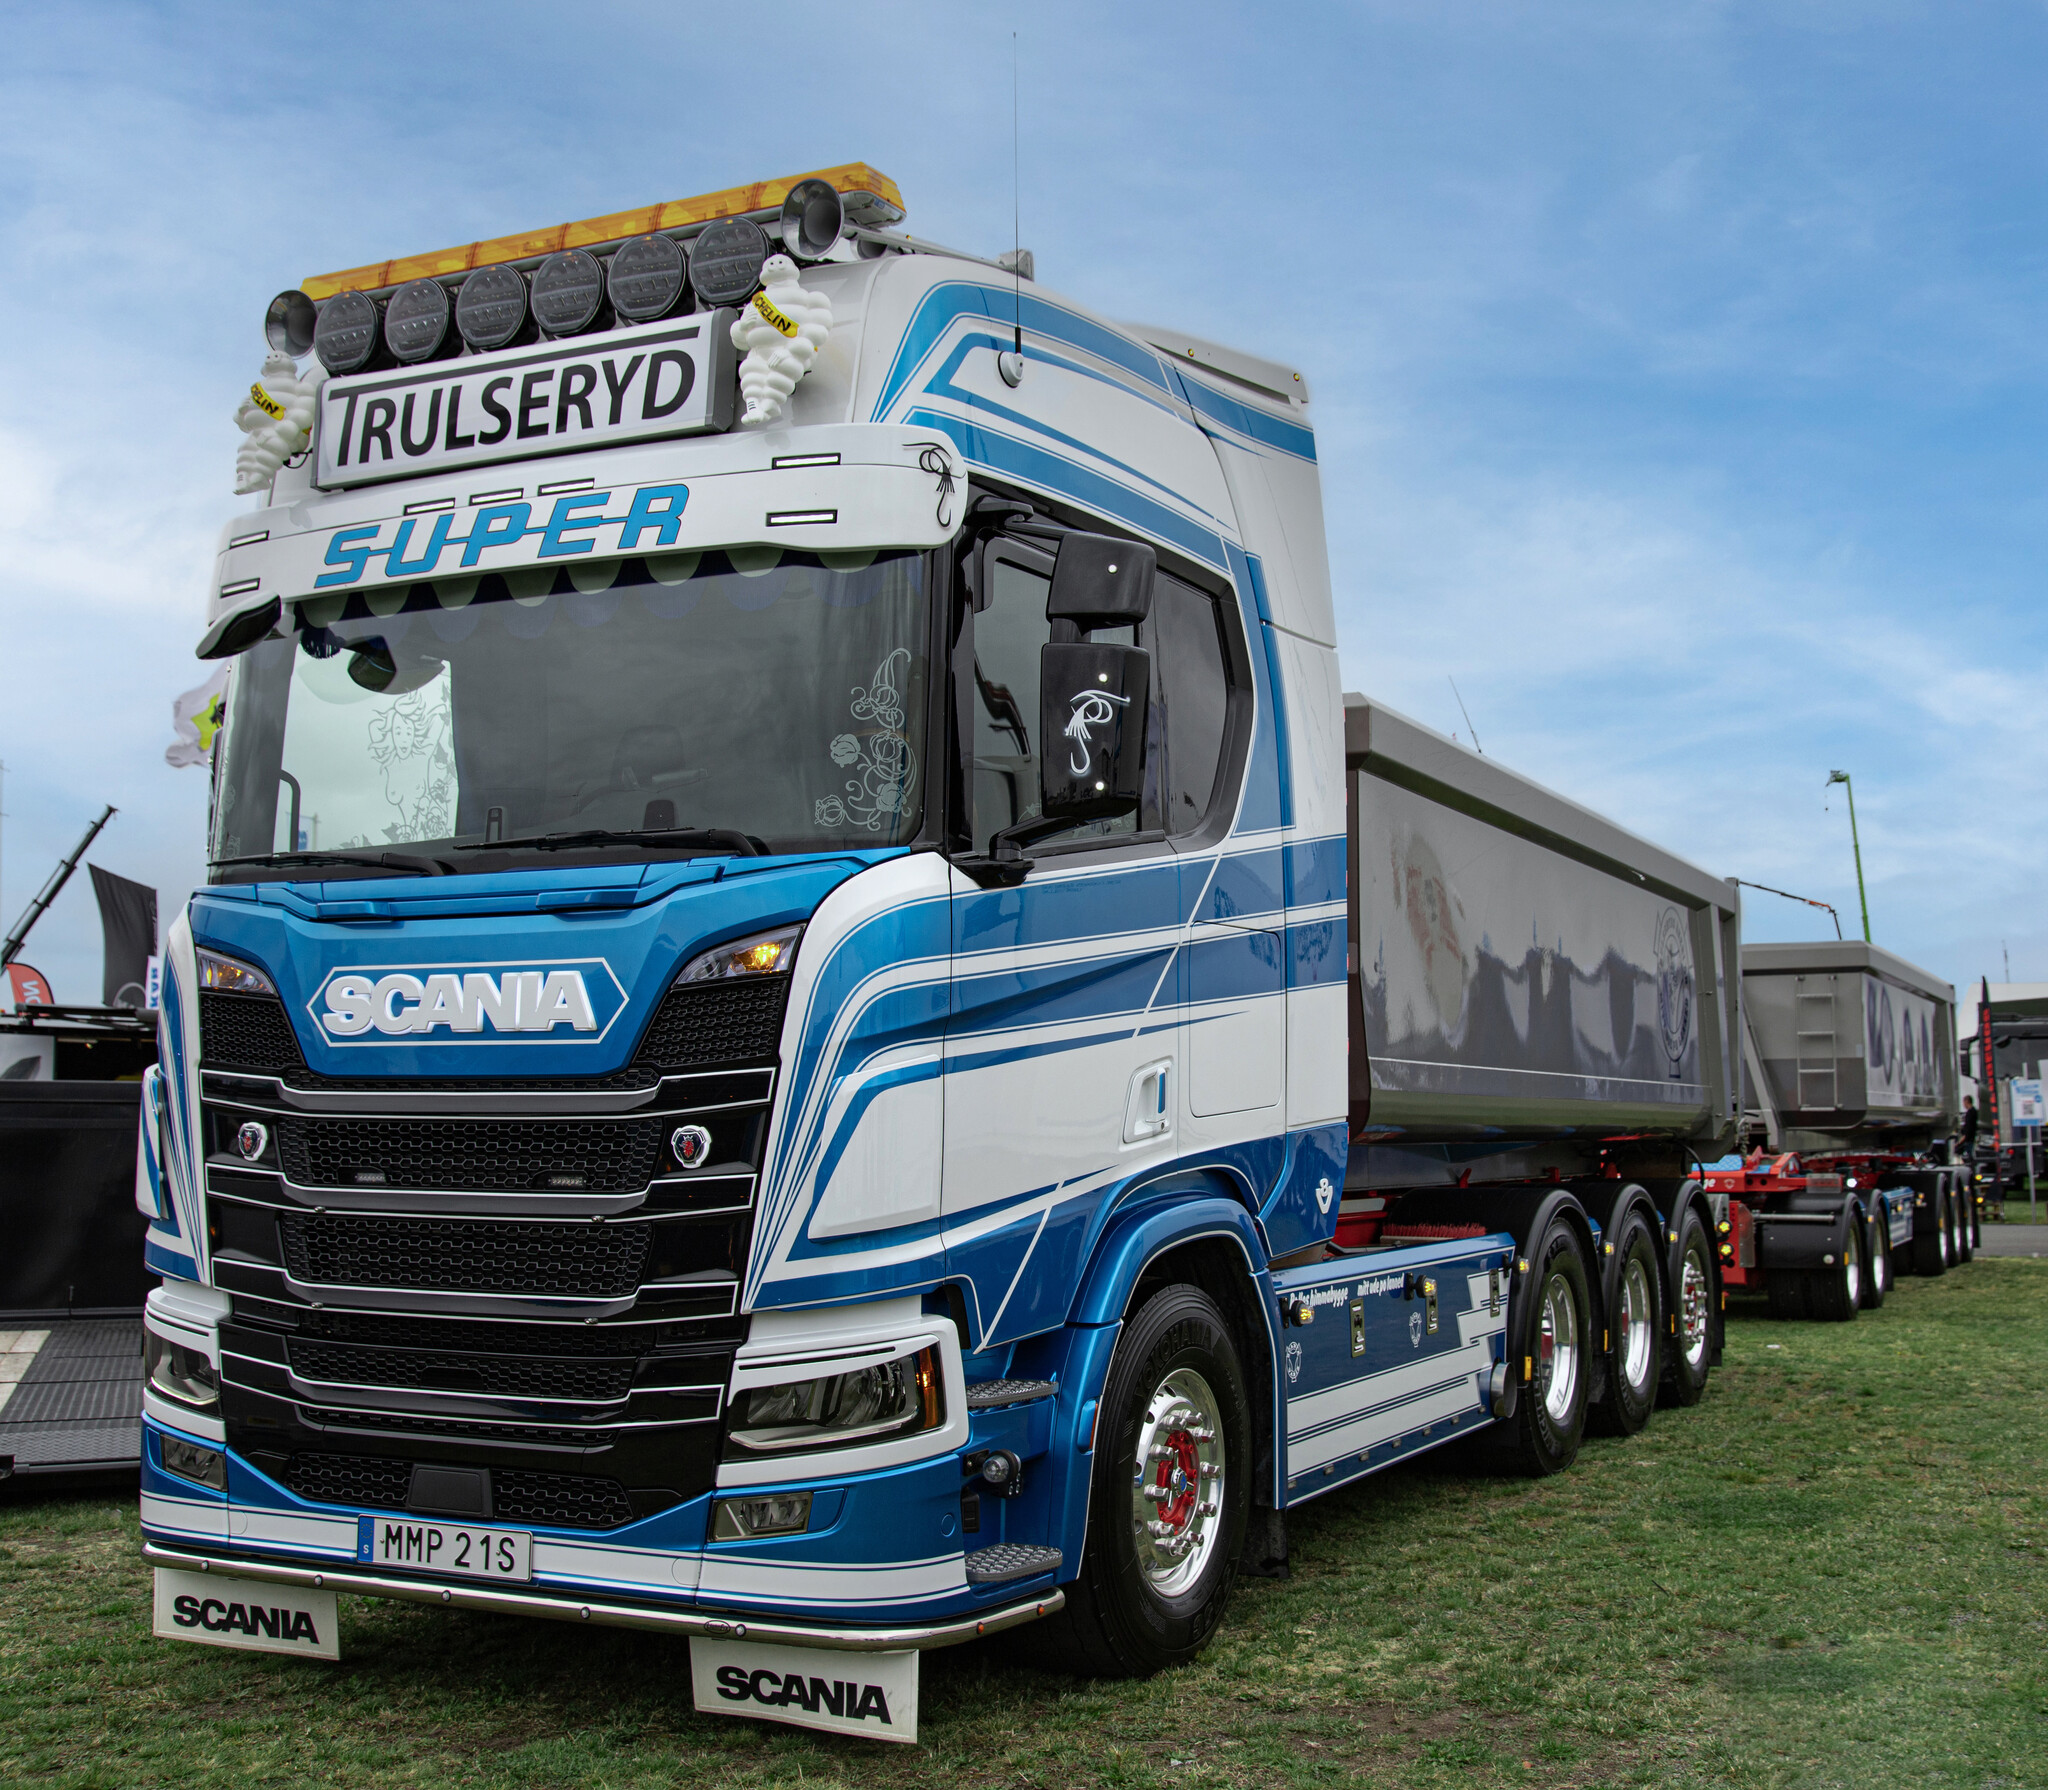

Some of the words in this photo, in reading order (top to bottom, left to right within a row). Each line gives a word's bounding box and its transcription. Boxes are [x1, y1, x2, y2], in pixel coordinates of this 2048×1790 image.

[754, 296, 792, 332] CHELIN
[327, 326, 700, 466] TRULSERYD
[313, 483, 690, 589] SUPER
[322, 970, 597, 1036] SCANIA
[363, 1544, 370, 1554] S
[384, 1523, 443, 1564] MMP
[454, 1531, 515, 1573] 21S
[172, 1594, 321, 1645] SCANIA
[716, 1665, 893, 1725] SCANIA
